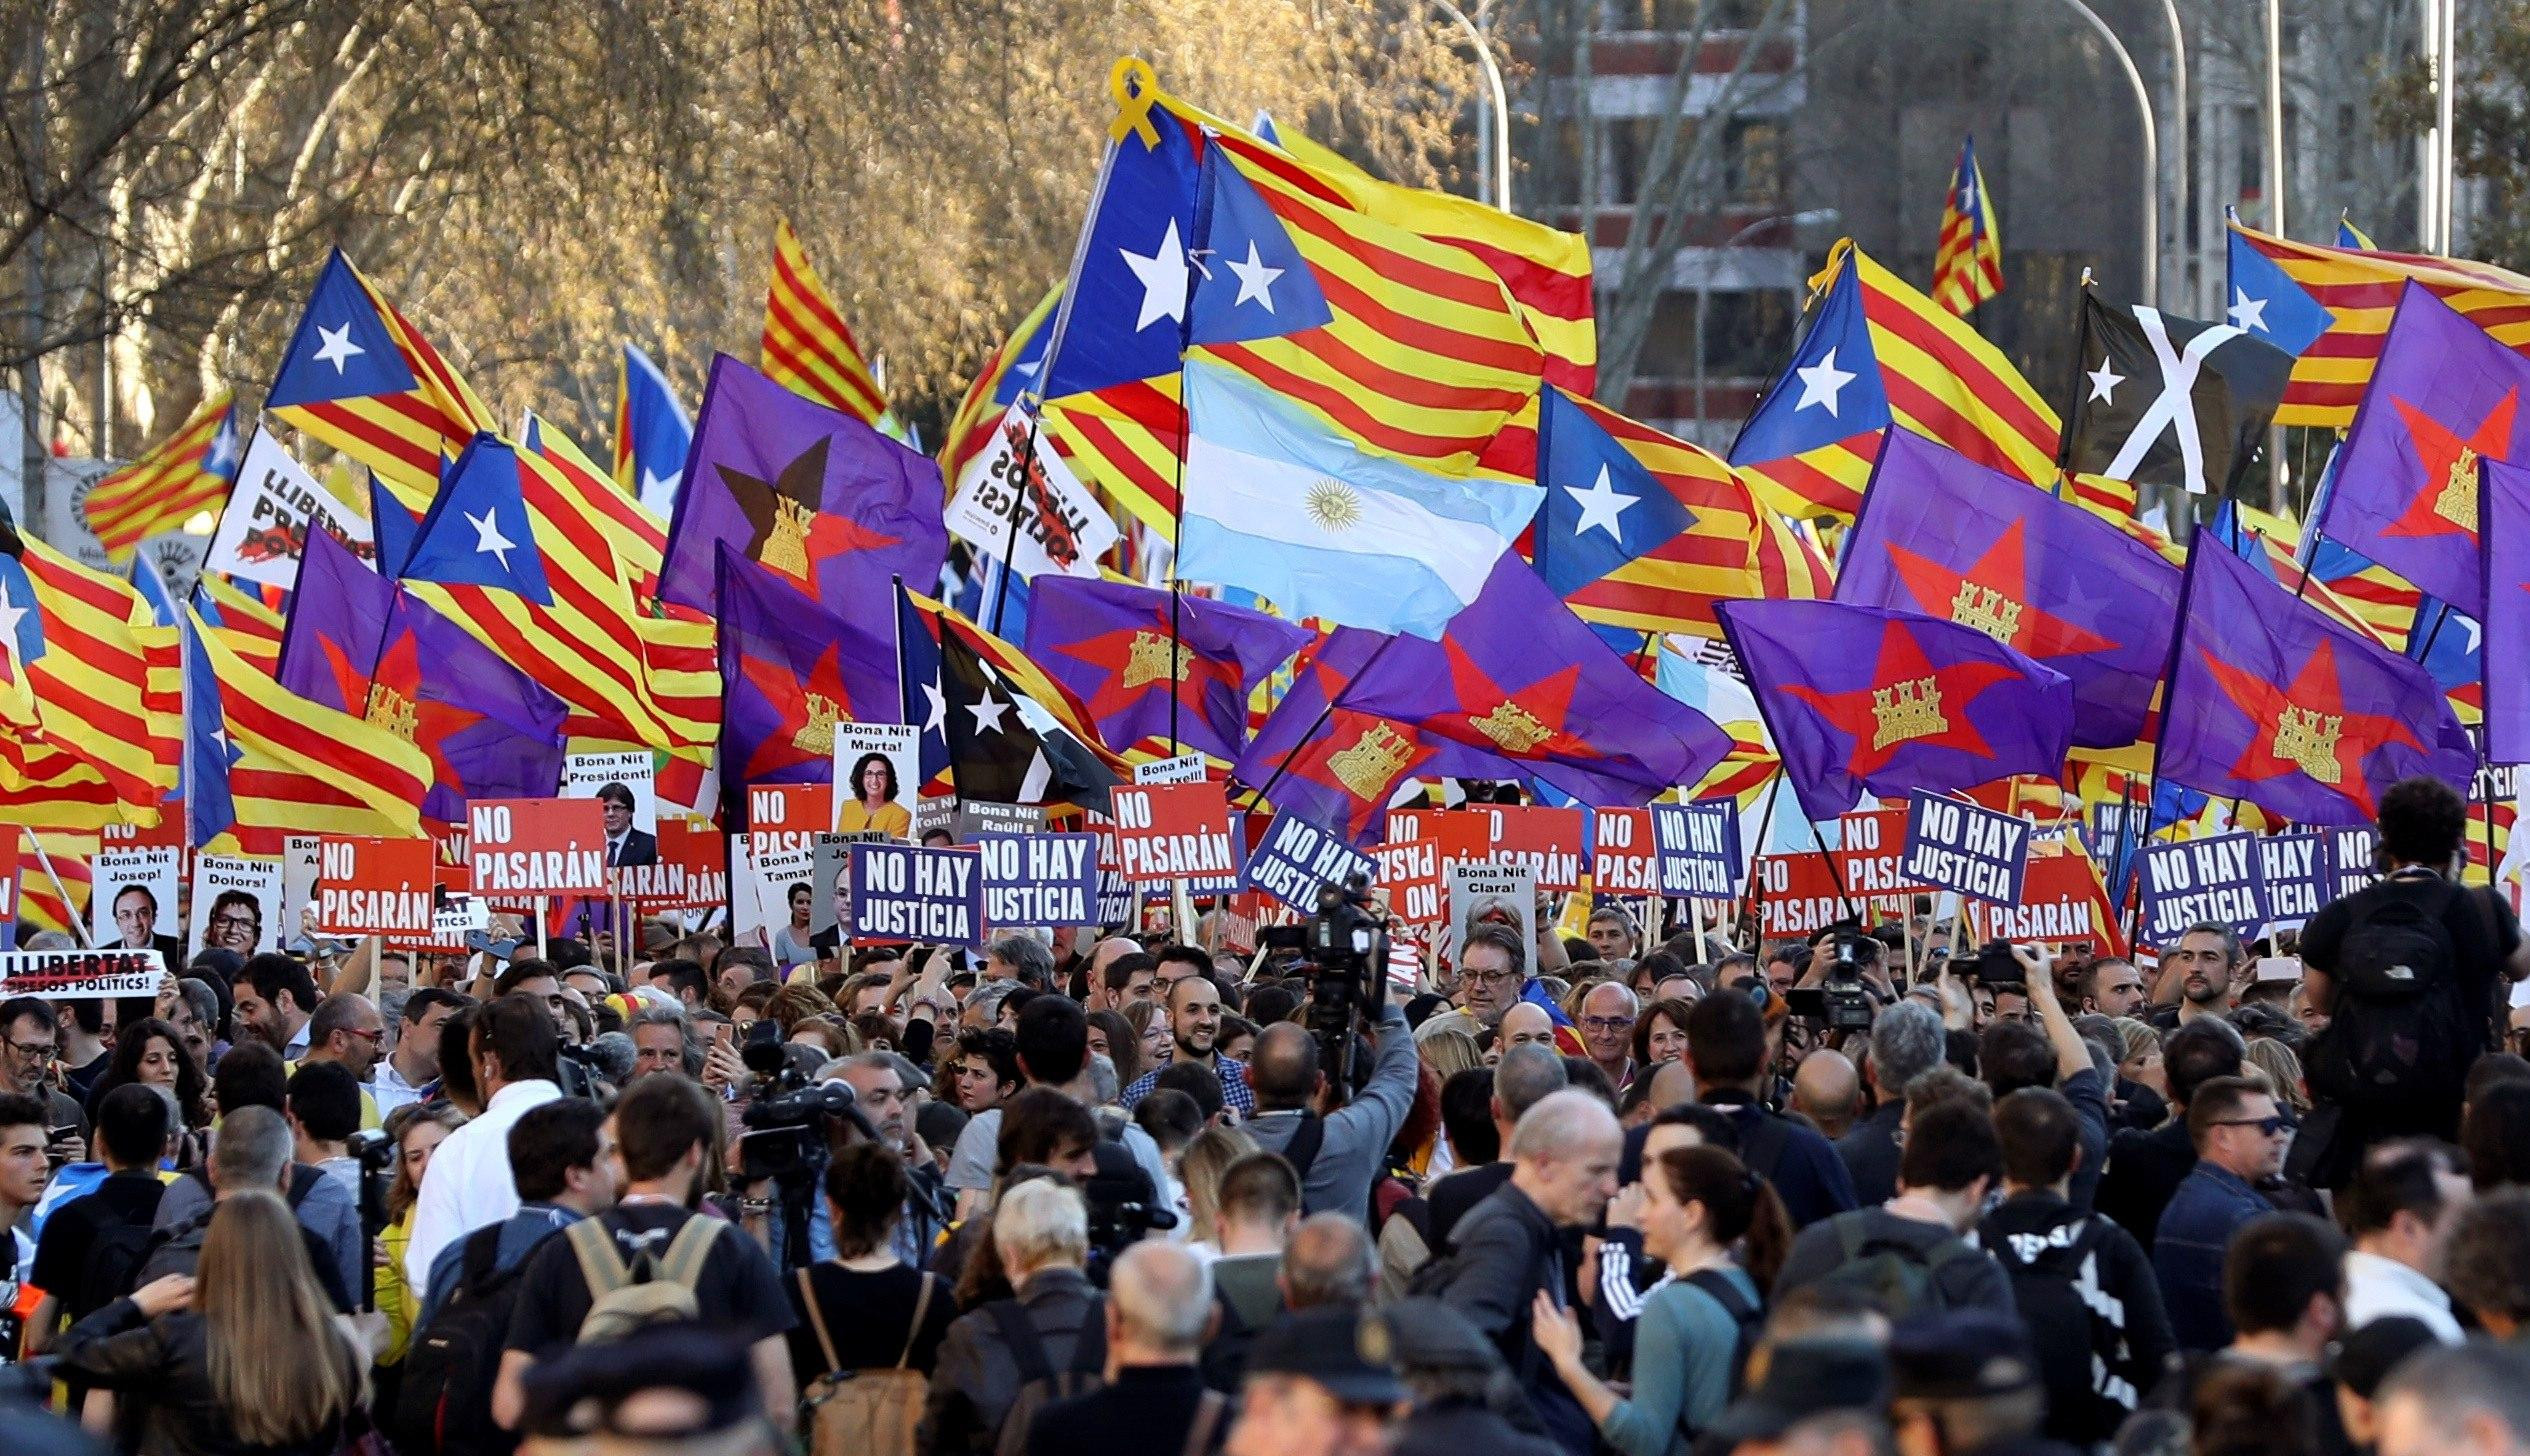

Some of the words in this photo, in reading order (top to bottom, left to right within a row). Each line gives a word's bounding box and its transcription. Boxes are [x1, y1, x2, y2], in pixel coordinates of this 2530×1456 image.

[843, 724, 882, 735] Bona
[888, 726, 911, 737] Nit
[851, 740, 902, 752] Marta!
[569, 769, 651, 782] President!
[575, 757, 615, 767] Bona
[621, 753, 644, 764] Nit
[1142, 763, 1175, 776] Bona
[1179, 756, 1198, 769] Nit
[473, 806, 513, 844] NO
[752, 791, 786, 824] NO
[969, 803, 1010, 817] Bona
[1015, 807, 1039, 819] Nit
[1117, 791, 1151, 829] NO
[821, 834, 859, 846] Bona
[863, 832, 884, 843] Nit
[1122, 824, 1232, 875] PASARÁN
[1274, 817, 1319, 863] NO
[1598, 813, 1632, 848] NO
[1660, 810, 1687, 851] NO
[1687, 812, 1723, 854] HAY
[1845, 816, 1879, 851] NO
[1920, 799, 1960, 845] NO
[1964, 808, 2022, 863] HAY
[101, 856, 141, 867] Bona
[146, 853, 169, 864] Nit
[203, 858, 244, 871] Bona
[250, 861, 274, 873] Nit
[323, 842, 354, 880] NO
[475, 841, 602, 890] PASARÁN
[760, 855, 799, 868] Bona
[979, 839, 1019, 880] NO
[1029, 839, 1087, 880] HAY
[1369, 844, 1435, 884] PASA
[2148, 849, 2191, 893] NO
[2195, 838, 2249, 886] HAY
[2262, 839, 2315, 880] HAY
[2338, 831, 2372, 869] NO
[109, 869, 161, 881] Josep!
[209, 874, 266, 888] Dolors!
[607, 855, 685, 895] SARÁN
[765, 869, 813, 882] Tamar
[866, 851, 905, 894] NO
[915, 854, 973, 898] HAY
[1251, 854, 1322, 913] JUSTÍC
[1457, 867, 1497, 878] Bona
[1503, 867, 1527, 878] Nit
[1468, 883, 1516, 893] Clara!
[1596, 853, 1657, 890] PASA
[1663, 854, 1729, 894] JUSTÍCIA
[1908, 843, 2010, 901] JUSTÍCIA
[322, 881, 429, 930] PASARÁN
[858, 897, 970, 939] JUSTÍCIA
[1406, 883, 1438, 919] NO
[1990, 893, 2089, 939] PASARÁN
[2154, 886, 2259, 934] JUSTÍCIA
[6, 953, 151, 978] LLIBERTAT
